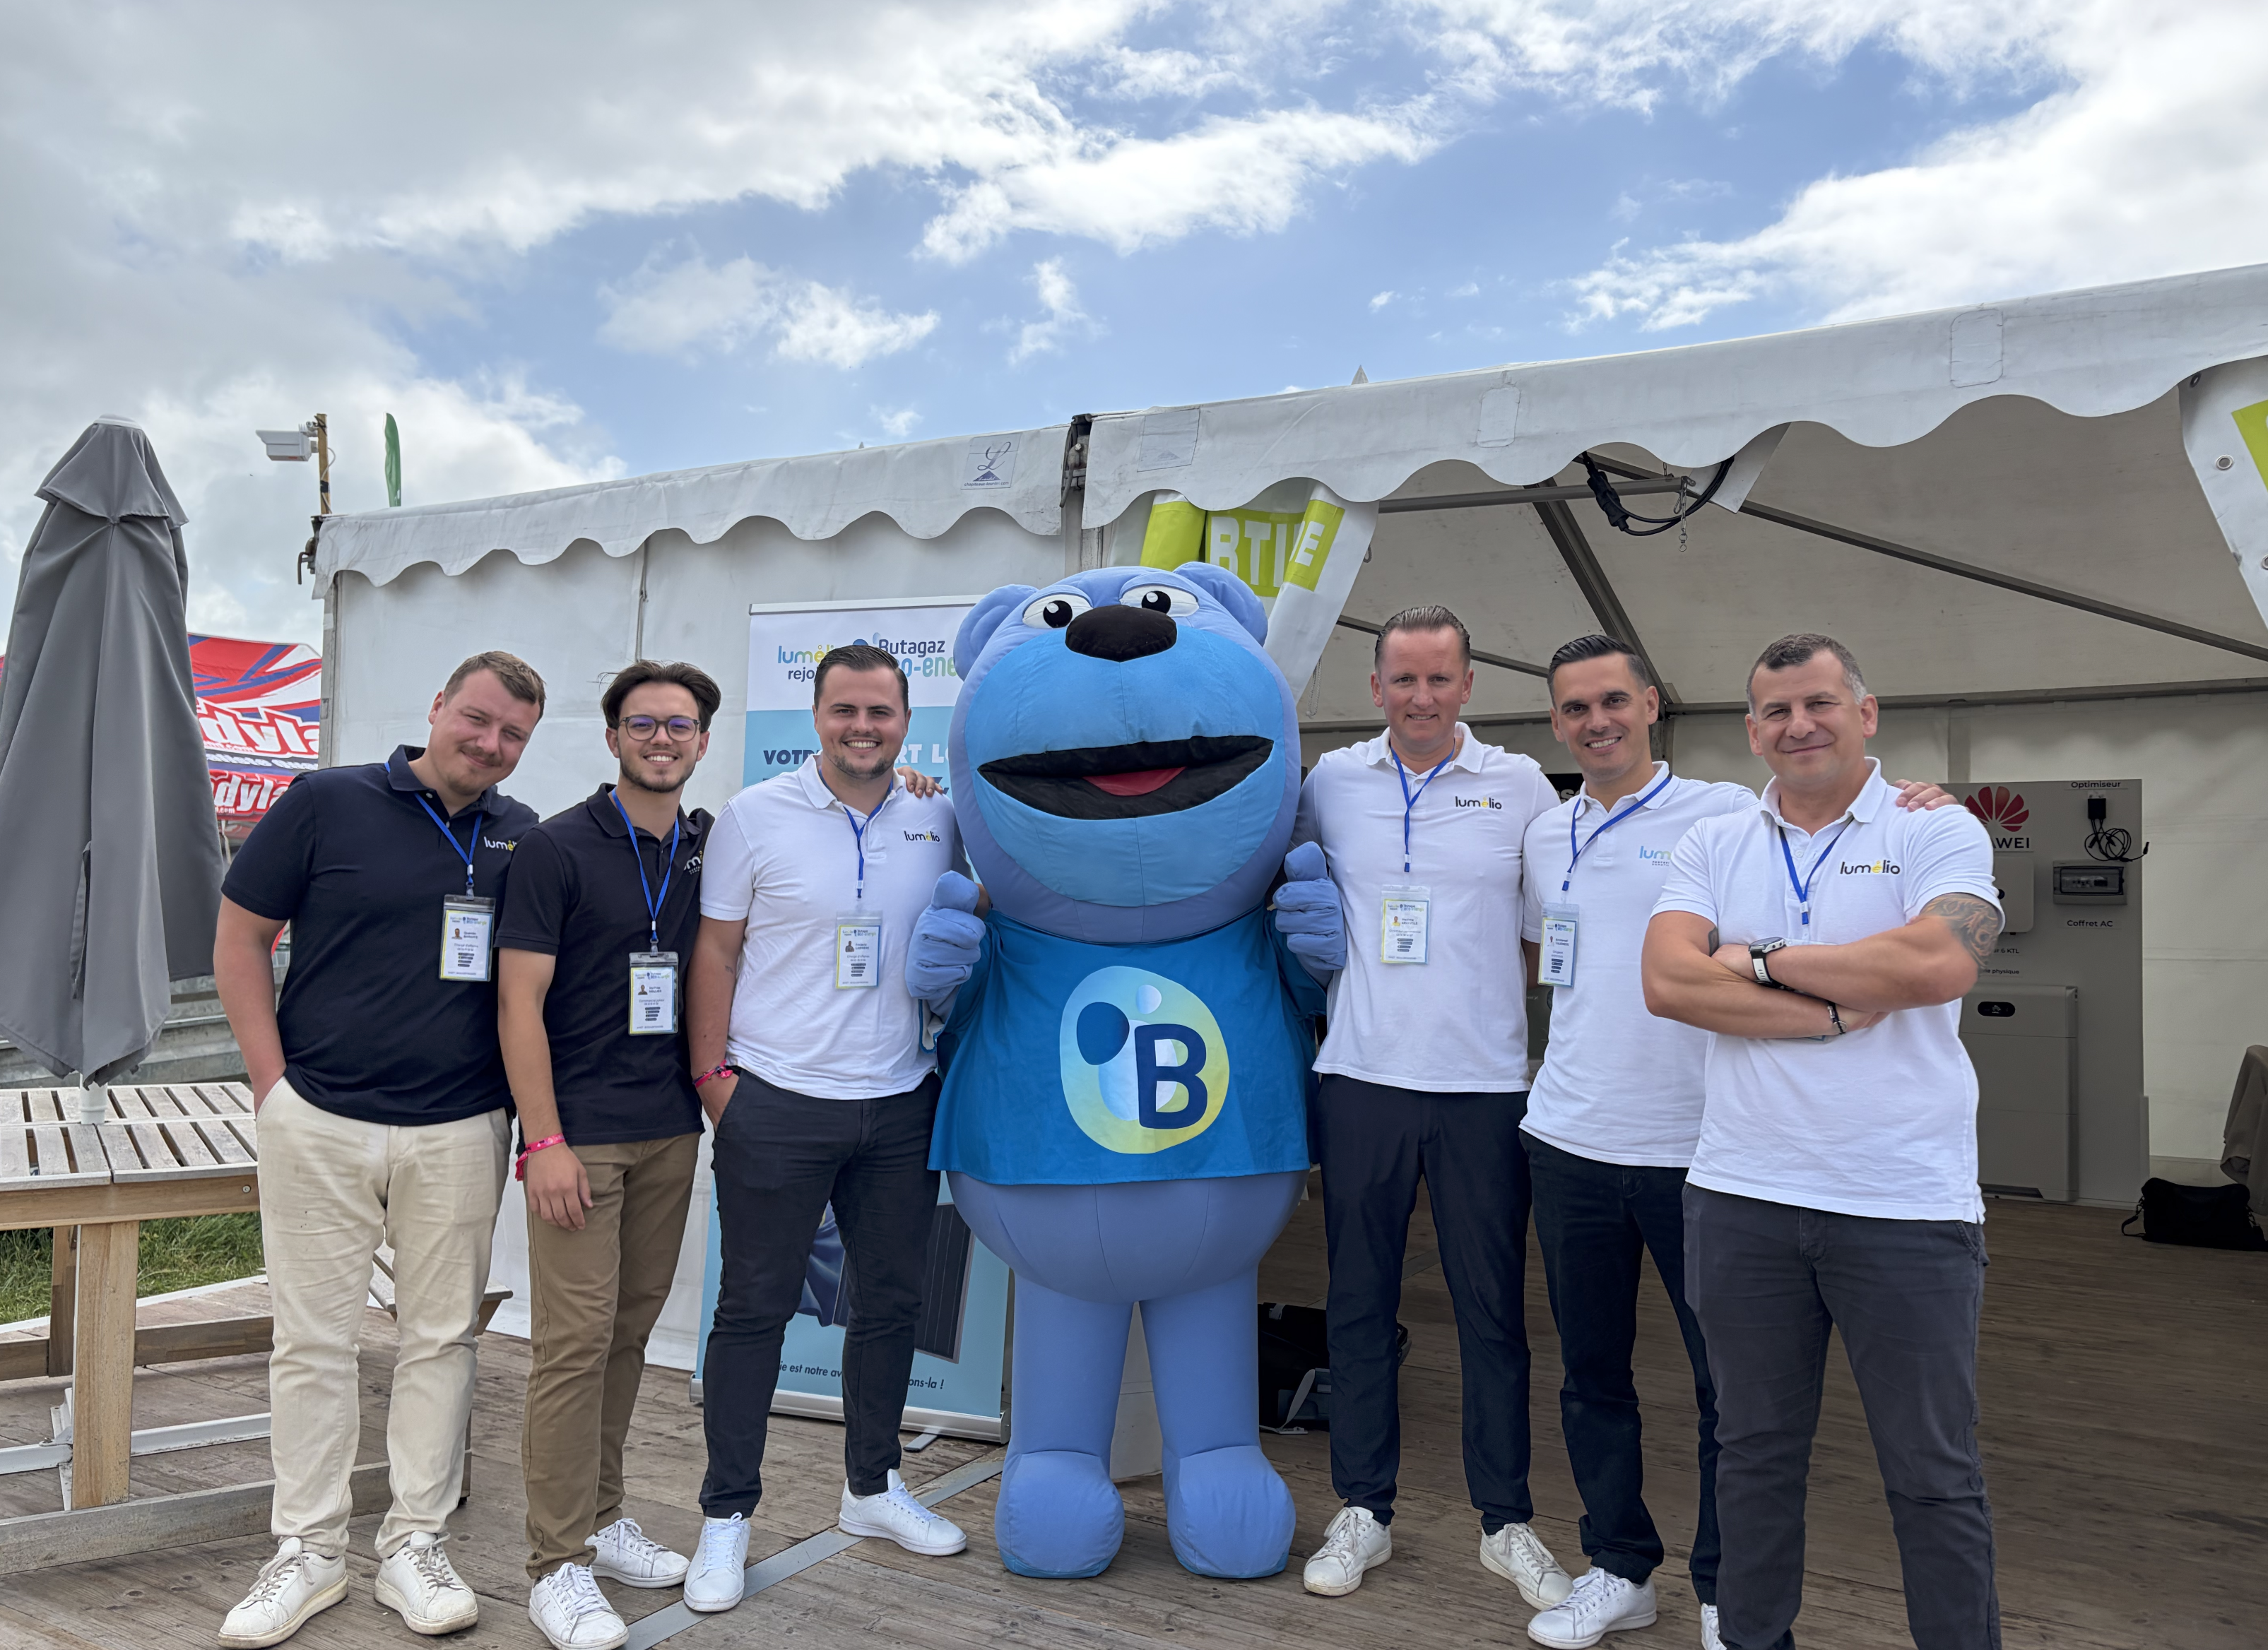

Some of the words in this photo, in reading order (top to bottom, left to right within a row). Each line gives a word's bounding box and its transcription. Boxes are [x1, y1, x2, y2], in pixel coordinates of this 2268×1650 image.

[878, 639, 945, 658] Butagaz
[788, 667, 815, 682] rejo
[894, 744, 922, 764] RT
[1134, 1023, 1208, 1129] B
[789, 1364, 803, 1373] est
[804, 1366, 828, 1377] notre
[909, 1376, 938, 1389] ons-la
